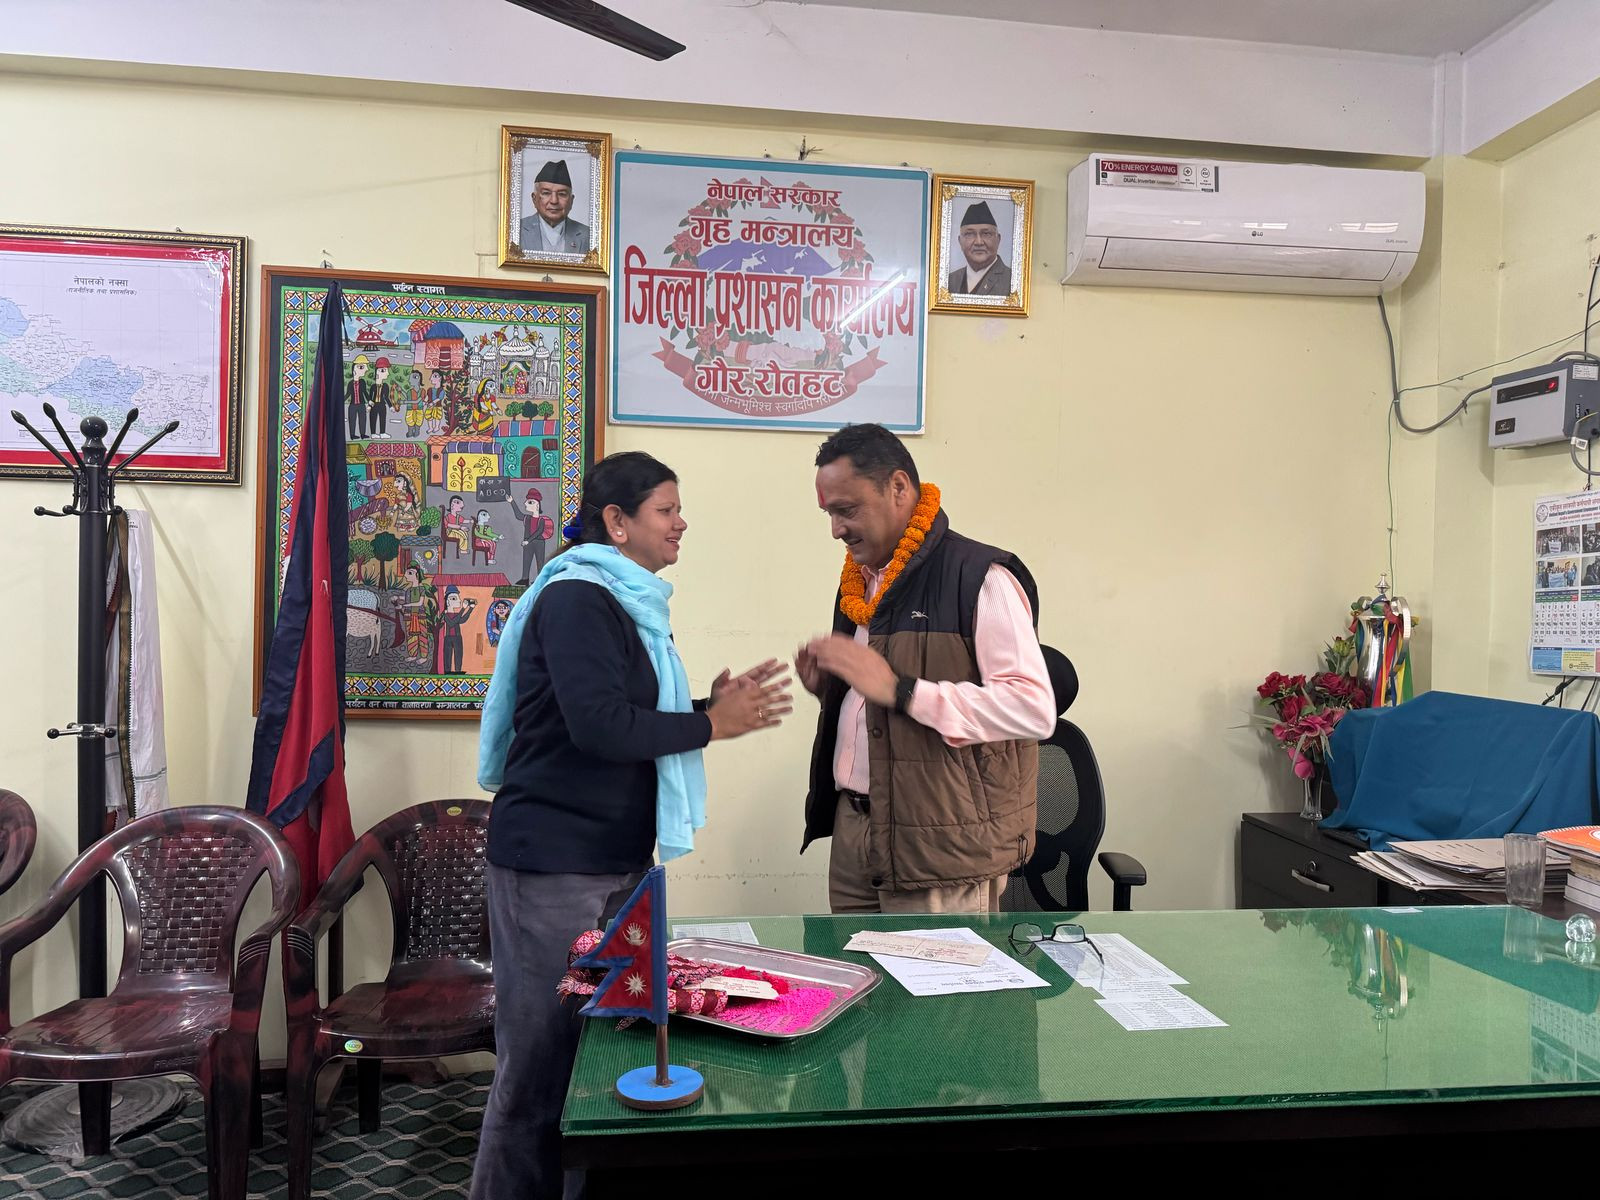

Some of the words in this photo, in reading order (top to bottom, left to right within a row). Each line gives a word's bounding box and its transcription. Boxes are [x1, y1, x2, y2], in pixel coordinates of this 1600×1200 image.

[1102, 162, 1120, 171] 70%
[1121, 164, 1149, 172] ENERGY
[1150, 165, 1176, 173] SAVING
[707, 178, 764, 201] नेपाल
[770, 185, 842, 206] सरकार
[689, 217, 732, 247] गृह
[741, 220, 854, 248] मन्त्रालय
[73, 275, 104, 286] नेपालको
[392, 282, 414, 292] पर्यटन
[416, 285, 445, 295] स्वागत
[624, 245, 707, 328] जिल्ला
[715, 271, 804, 337] प्रशासन
[812, 265, 917, 337] कार्यालय
[753, 360, 845, 397] रौतहट
